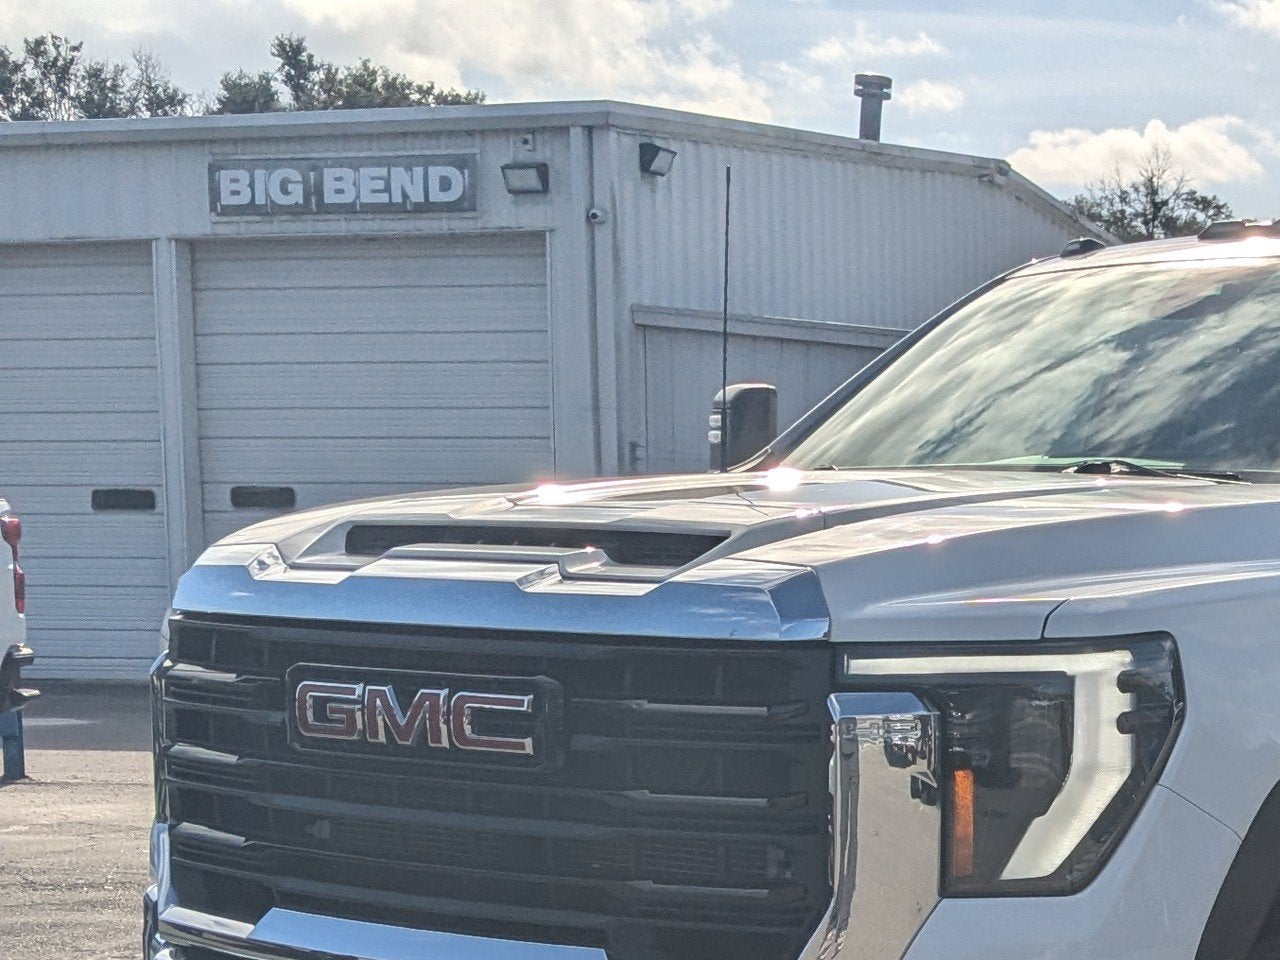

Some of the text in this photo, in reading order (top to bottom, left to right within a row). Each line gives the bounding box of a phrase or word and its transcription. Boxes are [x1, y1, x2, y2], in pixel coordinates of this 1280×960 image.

[219, 166, 464, 206] BIG BEND
[296, 681, 534, 755] GMC
